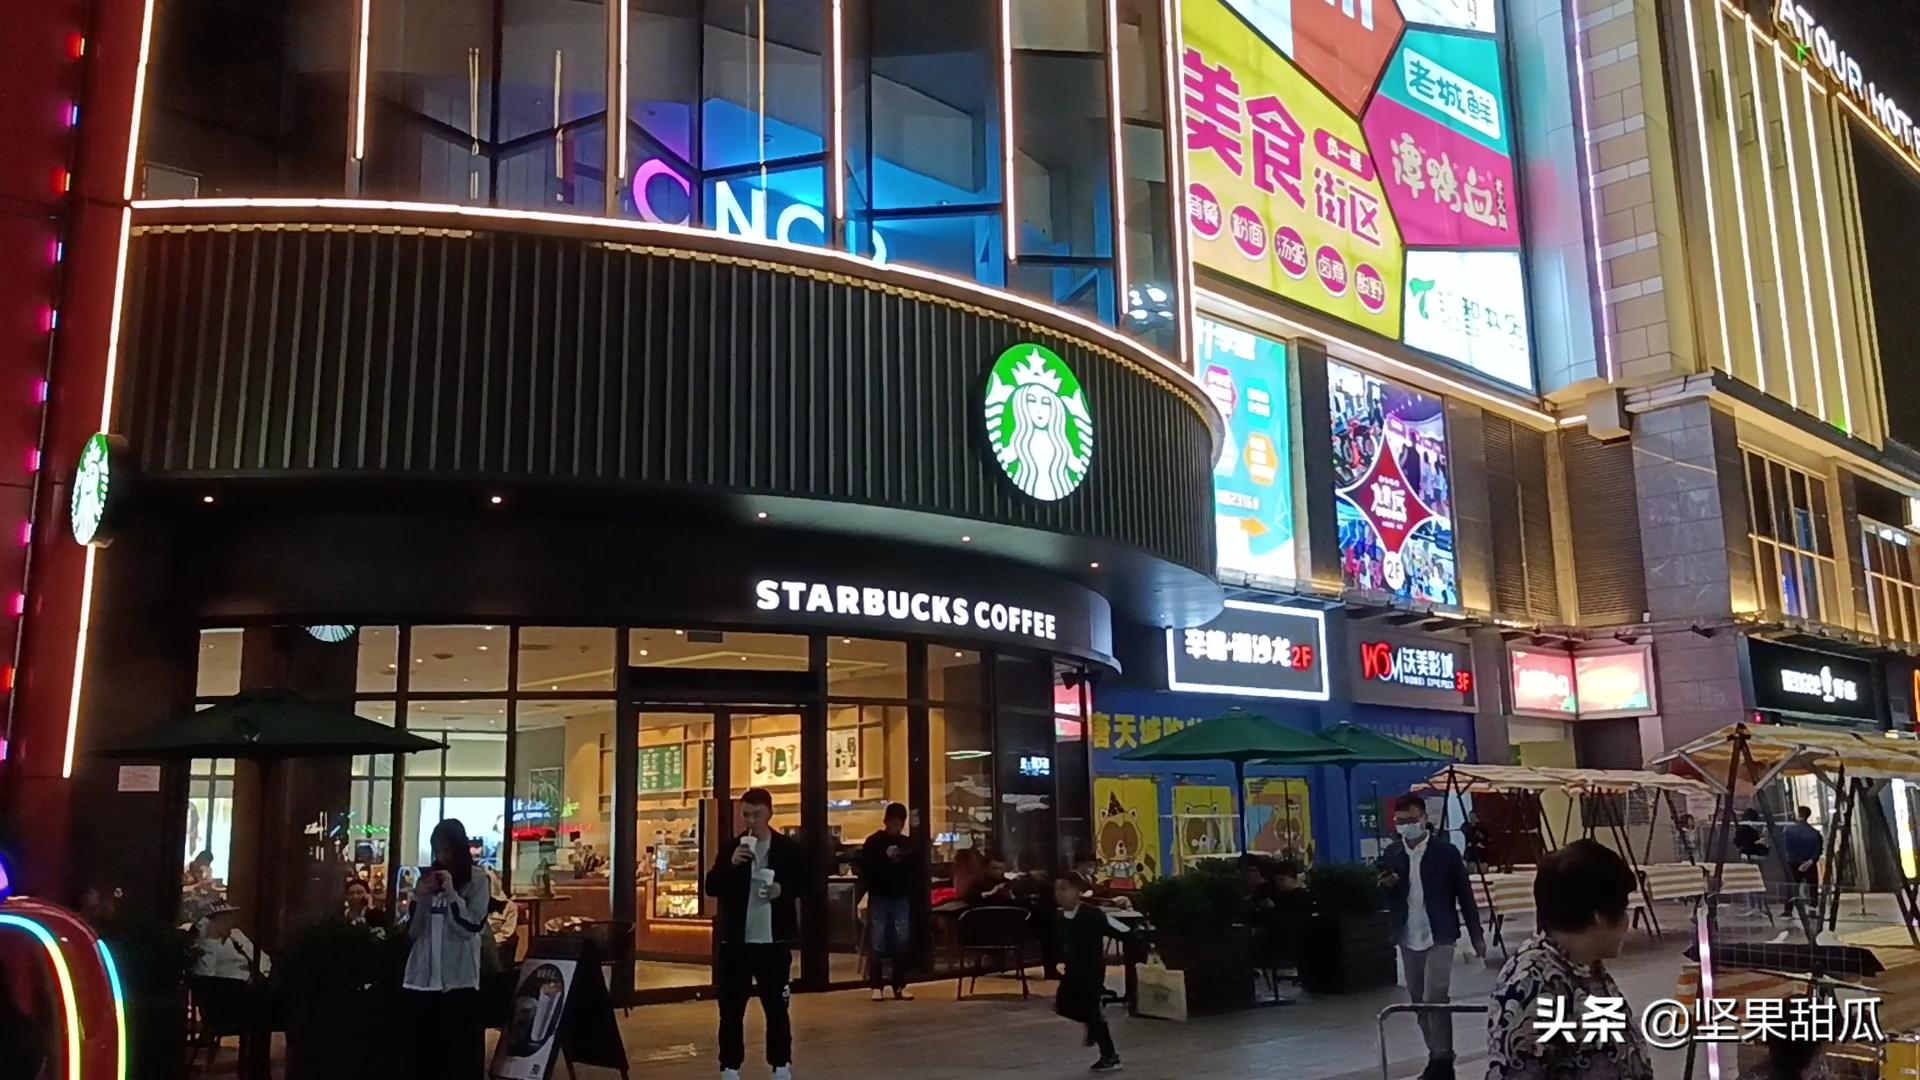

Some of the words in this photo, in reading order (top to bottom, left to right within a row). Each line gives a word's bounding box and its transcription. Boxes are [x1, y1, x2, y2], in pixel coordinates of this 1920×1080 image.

[1779, 0, 1864, 100] ATOUR
[1408, 60, 1494, 125] 老城鲜
[1183, 46, 1306, 210] 美食
[1313, 166, 1383, 247] 街区
[1232, 212, 1263, 249] 粉面
[1276, 233, 1306, 269] 汤粥
[1318, 254, 1346, 286] 卤煮
[755, 579, 970, 627] STARBUCKS
[974, 601, 1057, 641] COFFEE
[1291, 645, 1313, 668] 2F
[1403, 647, 1455, 679] 沃美影城
[1456, 671, 1471, 692] 3F
